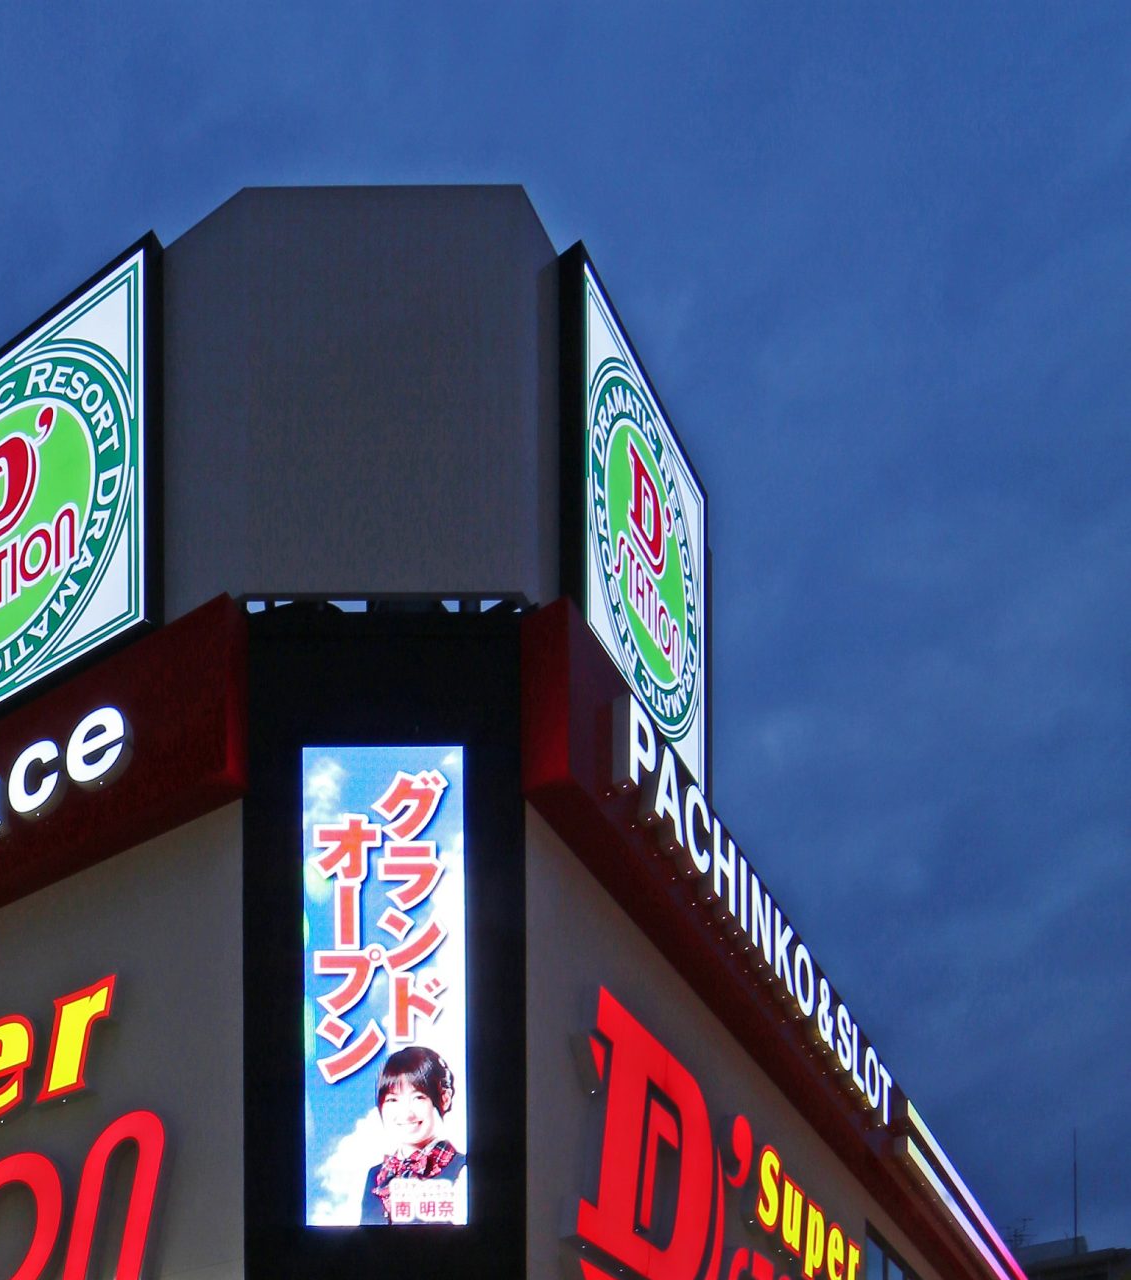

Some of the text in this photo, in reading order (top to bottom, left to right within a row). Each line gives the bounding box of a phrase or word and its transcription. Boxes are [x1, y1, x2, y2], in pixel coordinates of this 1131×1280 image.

[24, 361, 120, 452] RESORT
[613, 530, 683, 685] STATION
[313, 814, 386, 1085] オープン
[371, 769, 449, 1043] グランド
